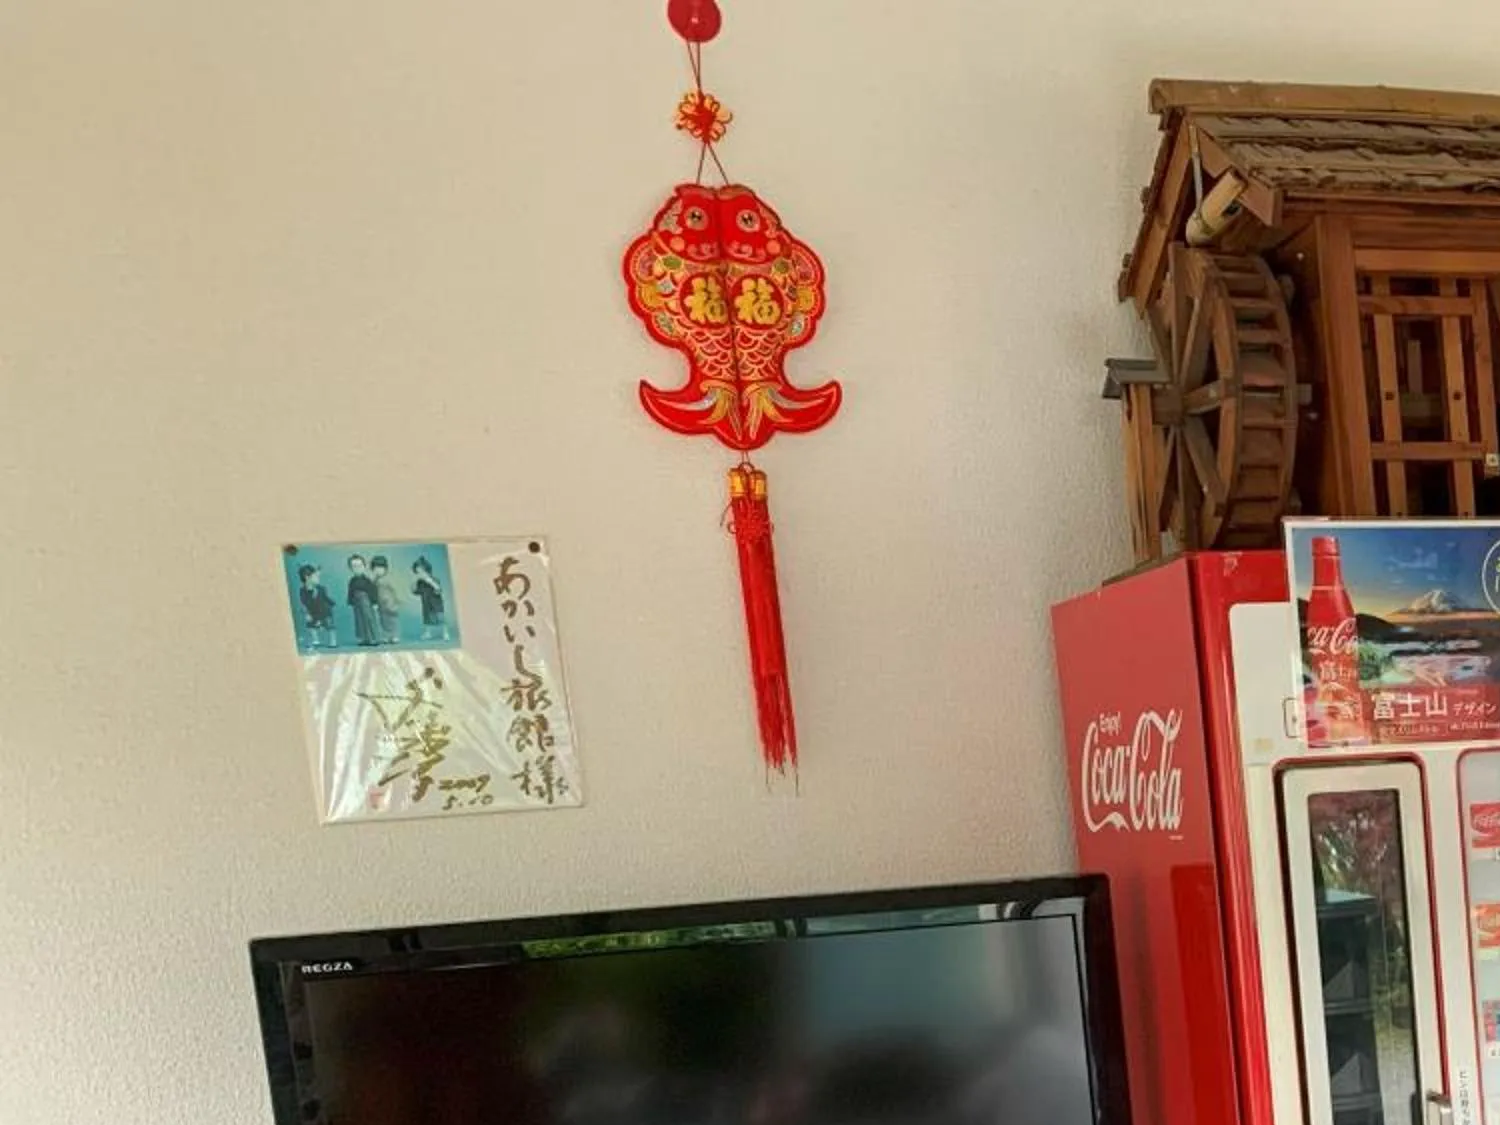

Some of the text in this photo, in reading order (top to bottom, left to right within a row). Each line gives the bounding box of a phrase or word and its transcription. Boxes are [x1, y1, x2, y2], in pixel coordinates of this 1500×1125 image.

[1372, 691, 1448, 720] 富士山
[1082, 708, 1184, 833] Coca-Cola
[301, 961, 353, 974] REGZA
